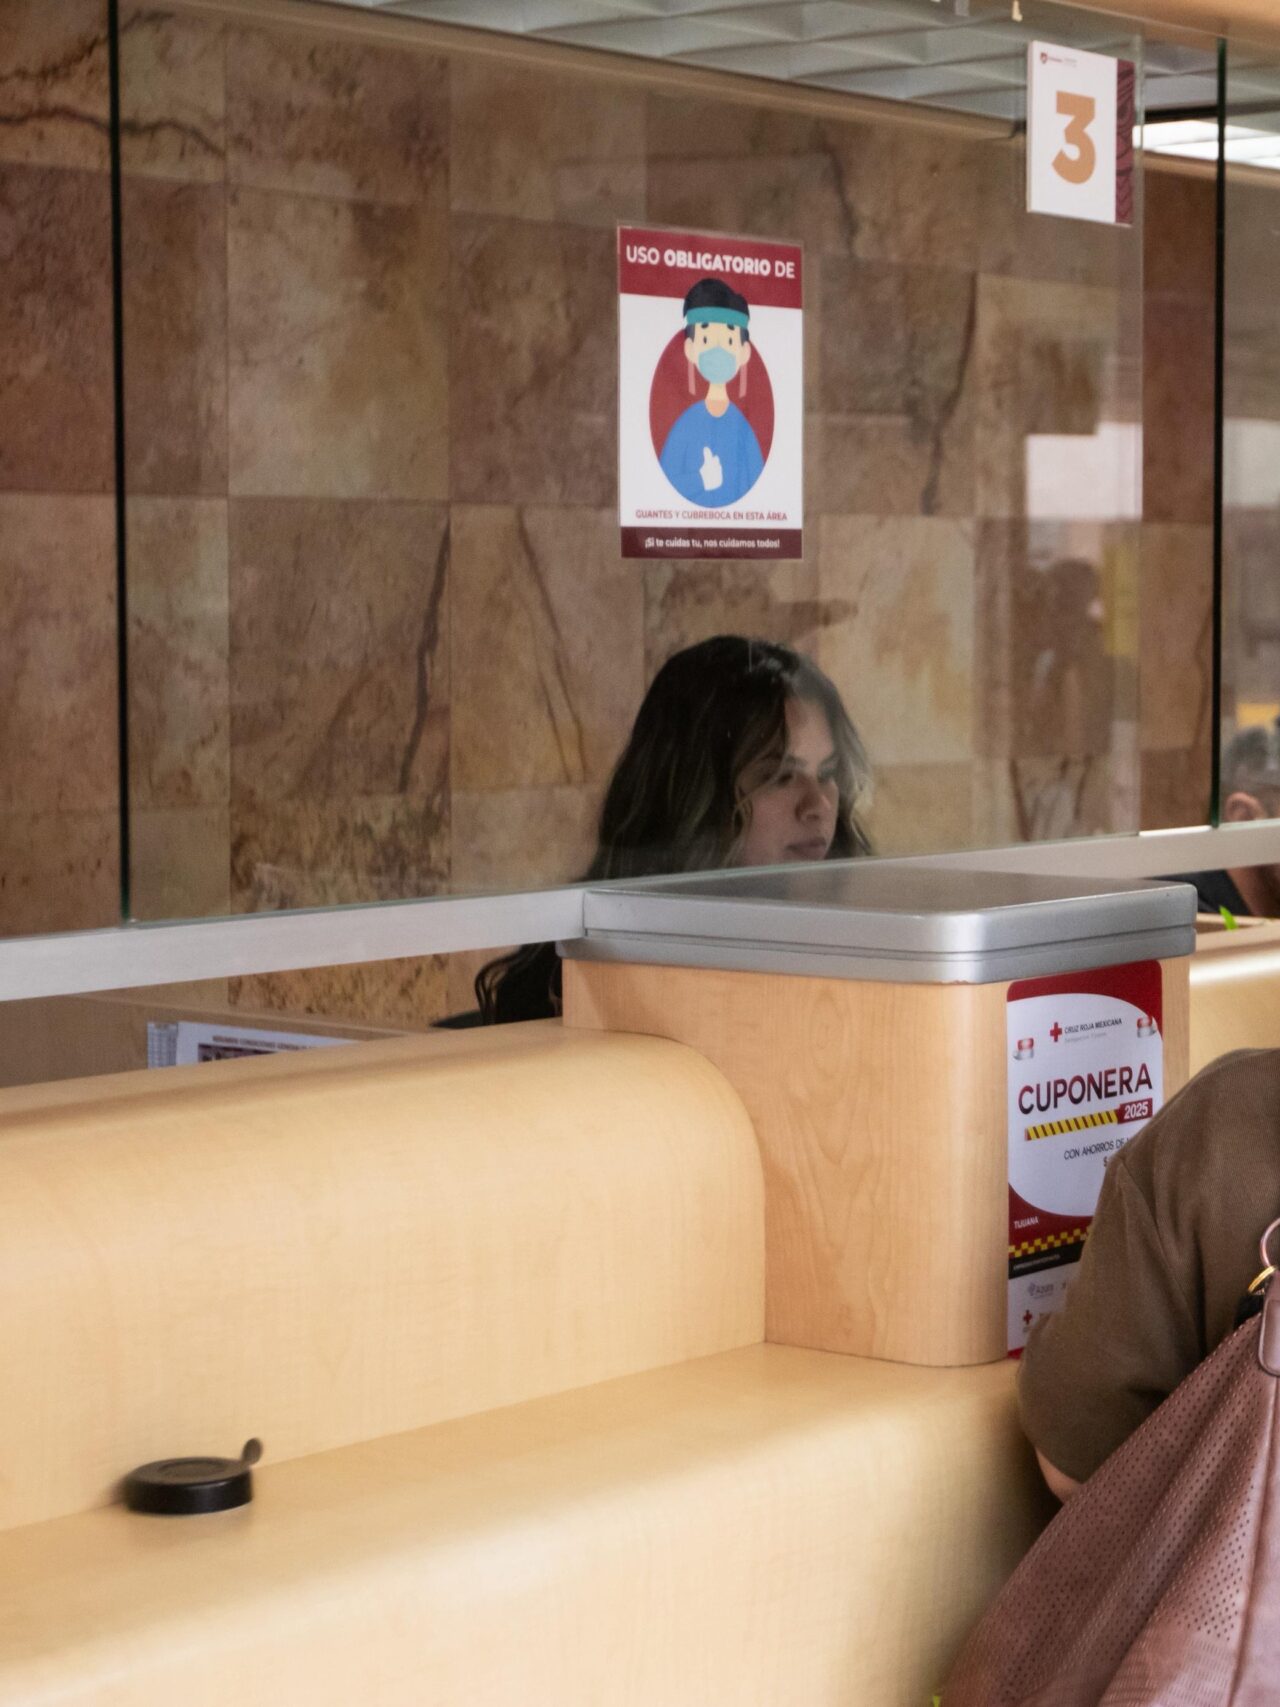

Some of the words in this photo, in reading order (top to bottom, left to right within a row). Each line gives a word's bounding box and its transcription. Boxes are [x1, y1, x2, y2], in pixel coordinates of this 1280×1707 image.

[1052, 91, 1096, 184] 3
[626, 245, 660, 264] USO
[664, 249, 771, 276] OBLIGATORIO
[774, 261, 795, 278] DE
[635, 510, 673, 519] GUANTES
[675, 511, 680, 519] Y
[682, 511, 731, 520] CUBREBOCA
[733, 511, 744, 520] EN
[746, 511, 765, 520] ESTA
[656, 538, 664, 547] te
[665, 537, 690, 548] cuidas
[704, 540, 718, 548] nos
[719, 538, 755, 548] cuidamos
[757, 538, 780, 548] todos!
[1064, 1025, 1079, 1034] CRUZ
[1080, 1022, 1094, 1031] ROJA
[1095, 1018, 1122, 1029] MEXICANA
[1018, 1062, 1153, 1115] CUPONERA
[1123, 1101, 1149, 1120] 2025
[1064, 1148, 1080, 1160] CON
[1082, 1140, 1114, 1156] AHORROS
[1014, 1216, 1039, 1229] TIJUANA
